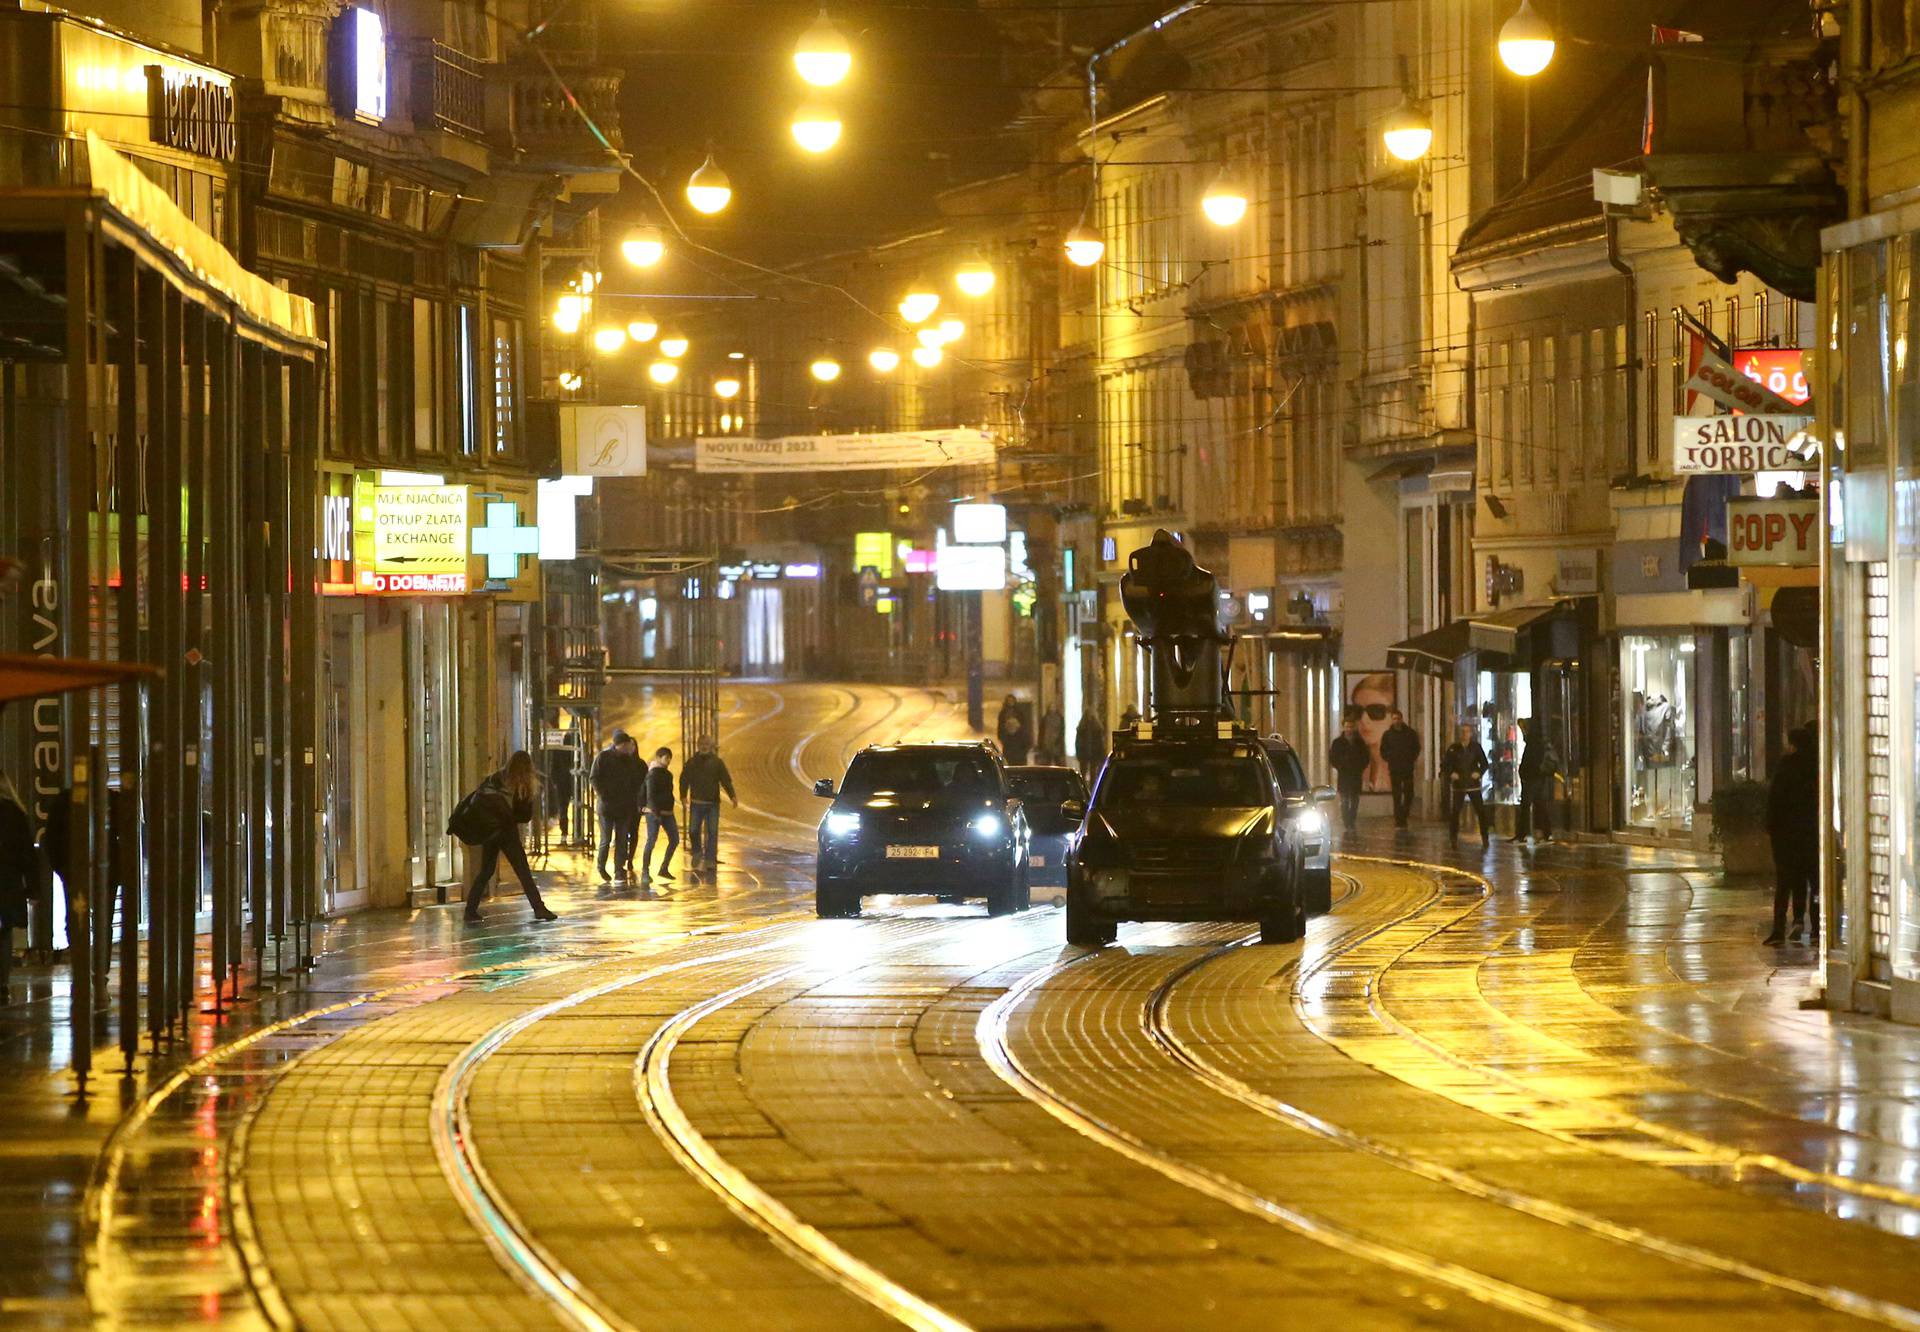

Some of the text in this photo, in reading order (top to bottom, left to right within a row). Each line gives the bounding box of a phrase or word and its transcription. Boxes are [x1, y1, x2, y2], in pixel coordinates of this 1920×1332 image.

[1697, 416, 1785, 445] SALON
[705, 442, 738, 453] NOVI
[380, 514, 462, 525] OTKUP ZLATA
[1732, 513, 1816, 551] COPY
[386, 533, 455, 544] EXCHANGE
